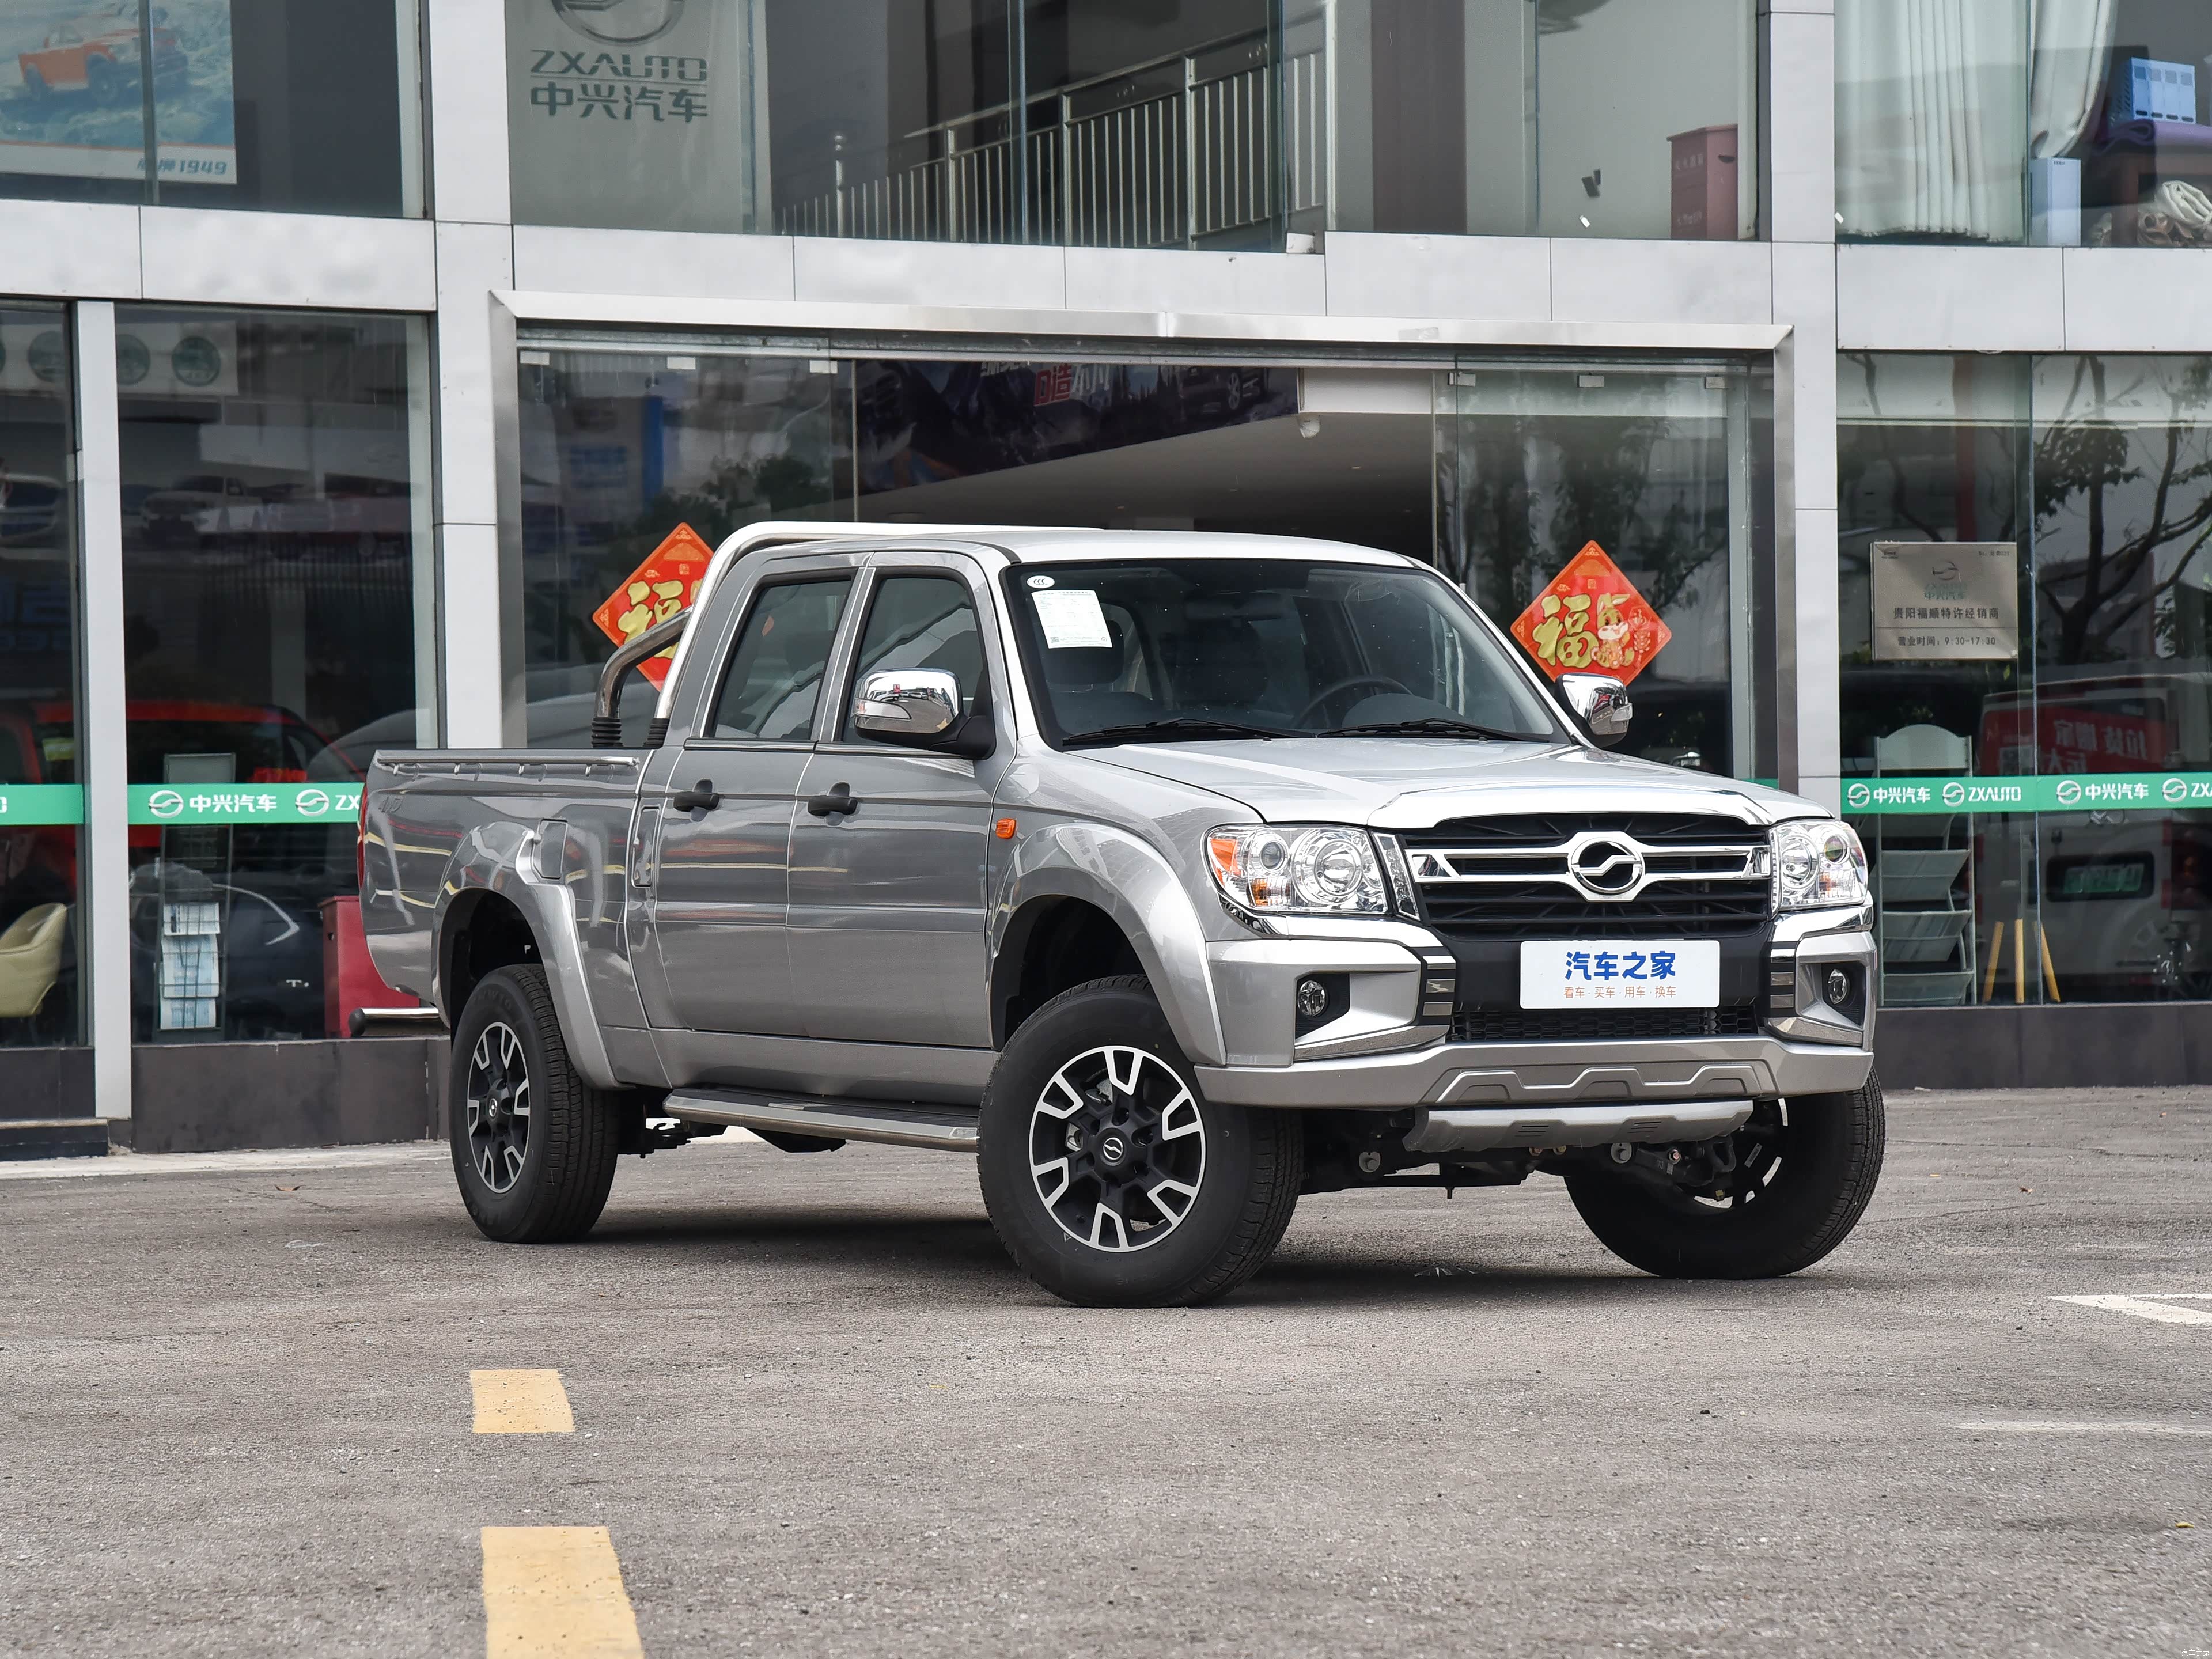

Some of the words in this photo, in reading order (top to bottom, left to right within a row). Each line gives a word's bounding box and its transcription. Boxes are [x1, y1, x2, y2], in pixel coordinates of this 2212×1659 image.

[531, 50, 707, 81] ZXAUTO
[531, 81, 708, 123] 中兴汽车
[1893, 608, 1999, 619] 贵阳福顺特许经销商
[1532, 594, 1600, 669] 福
[189, 794, 278, 813] 中兴汽车
[1873, 786, 1930, 804] 中兴汽车
[1968, 786, 2021, 802] ZXAUTO
[2085, 782, 2149, 800] 中兴汽车
[2191, 782, 2212, 798] ZX
[1565, 950, 1676, 980] 汽车之家
